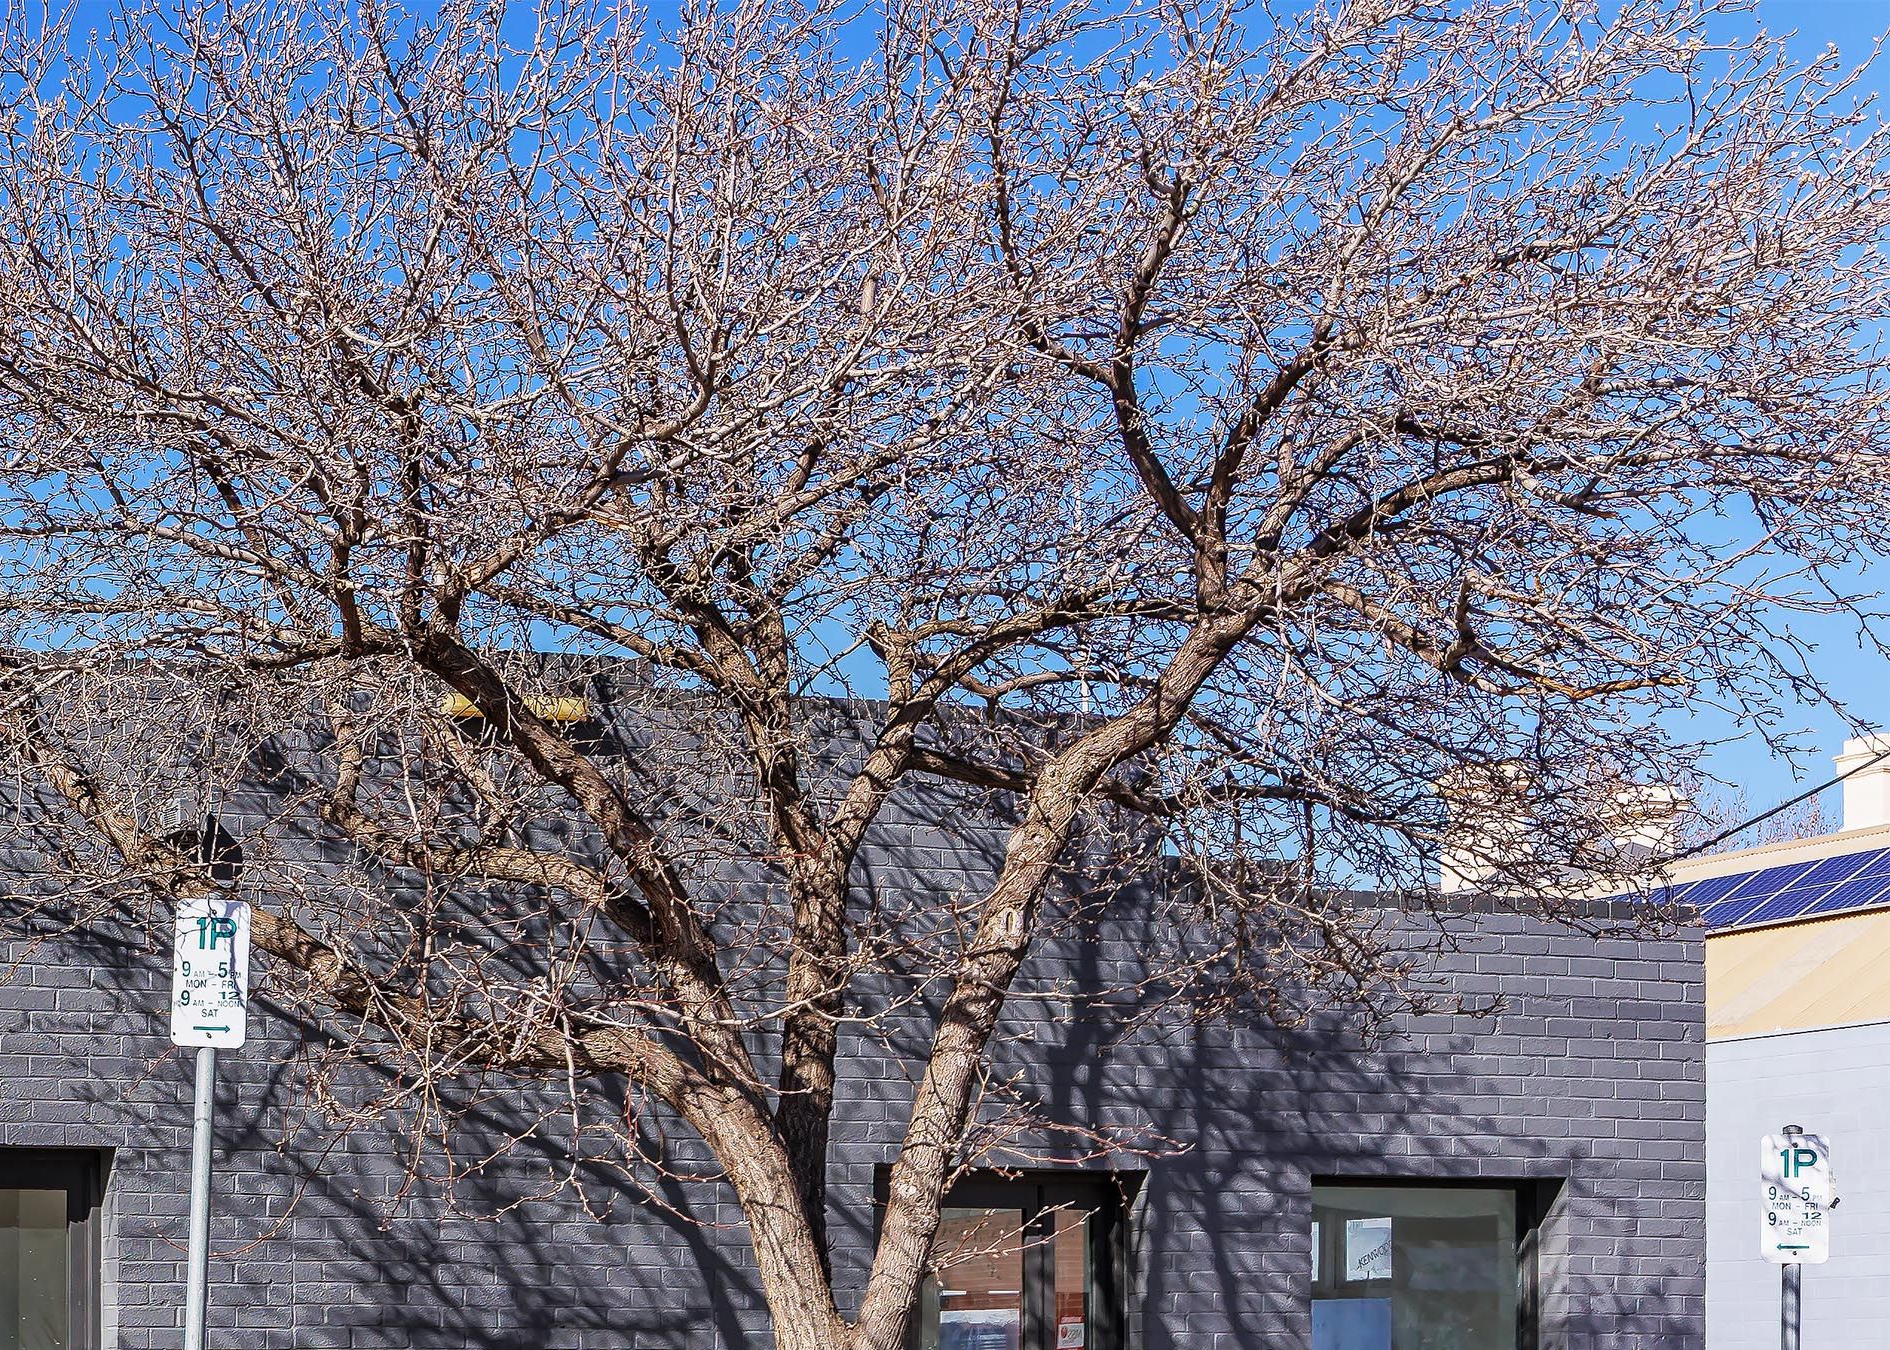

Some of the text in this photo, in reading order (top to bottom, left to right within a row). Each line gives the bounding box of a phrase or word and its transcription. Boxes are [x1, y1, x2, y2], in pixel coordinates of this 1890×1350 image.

[196, 916, 237, 950] 1P
[182, 961, 191, 977] 9
[217, 962, 228, 978] 5
[186, 980, 207, 989] MON
[180, 990, 191, 1006] 9
[218, 991, 241, 1000] 12
[201, 1008, 219, 1018] SAT
[1780, 1148, 1818, 1178] 1P
[1768, 1186, 1777, 1200] 9
[1801, 1186, 1810, 1201] 5
[1771, 1202, 1791, 1210] MON
[1804, 1202, 1818, 1210] FRI
[1768, 1211, 1777, 1226] 9
[1801, 1211, 1822, 1220] 12
[1786, 1227, 1803, 1236] SAT
